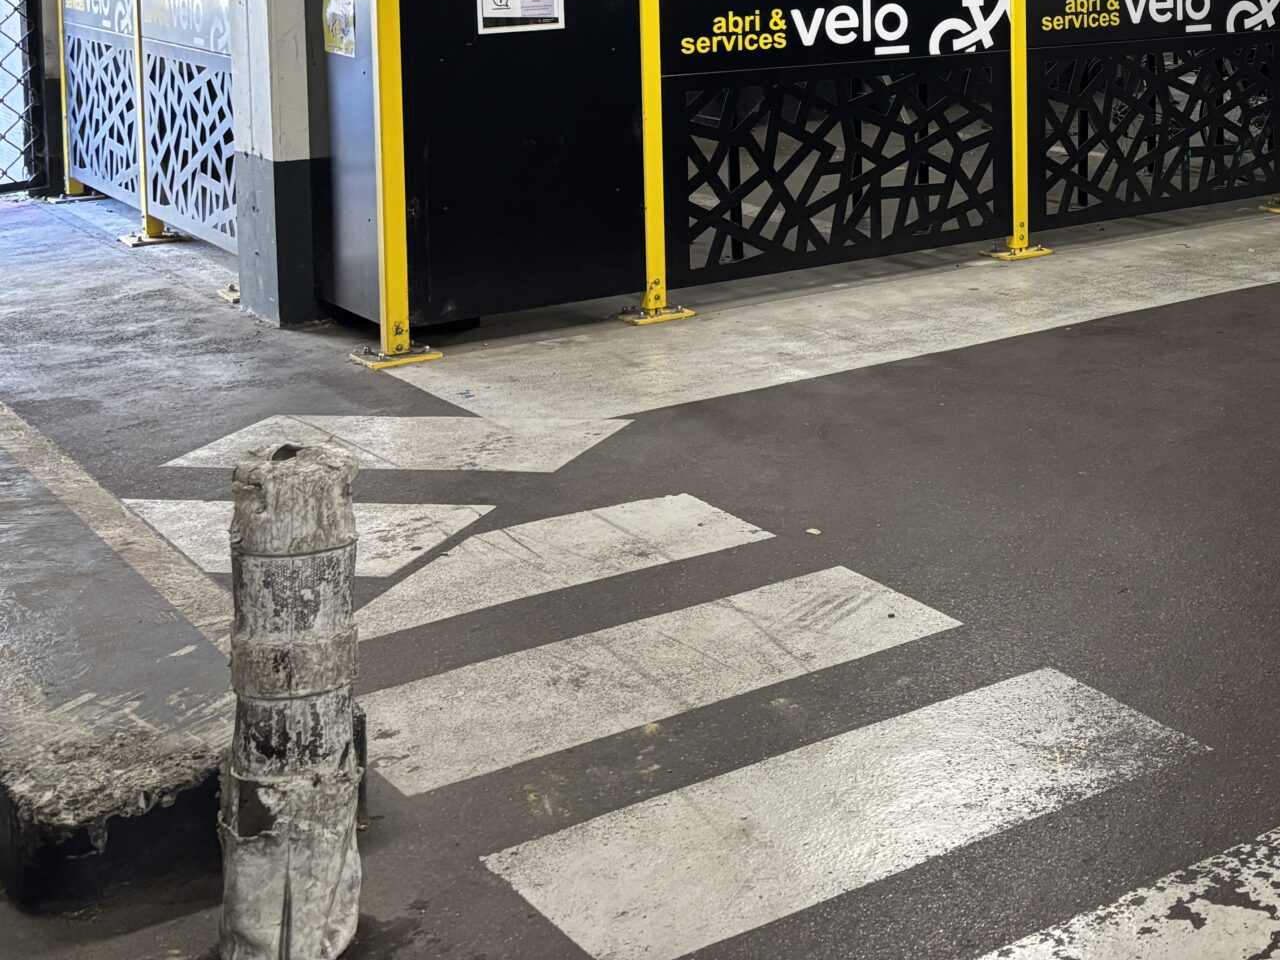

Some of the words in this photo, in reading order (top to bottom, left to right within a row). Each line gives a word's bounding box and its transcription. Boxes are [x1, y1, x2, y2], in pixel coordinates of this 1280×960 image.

[712, 9, 760, 35] abri
[768, 8, 788, 31] &
[1041, 11, 1121, 32] services
[680, 32, 788, 55] services
